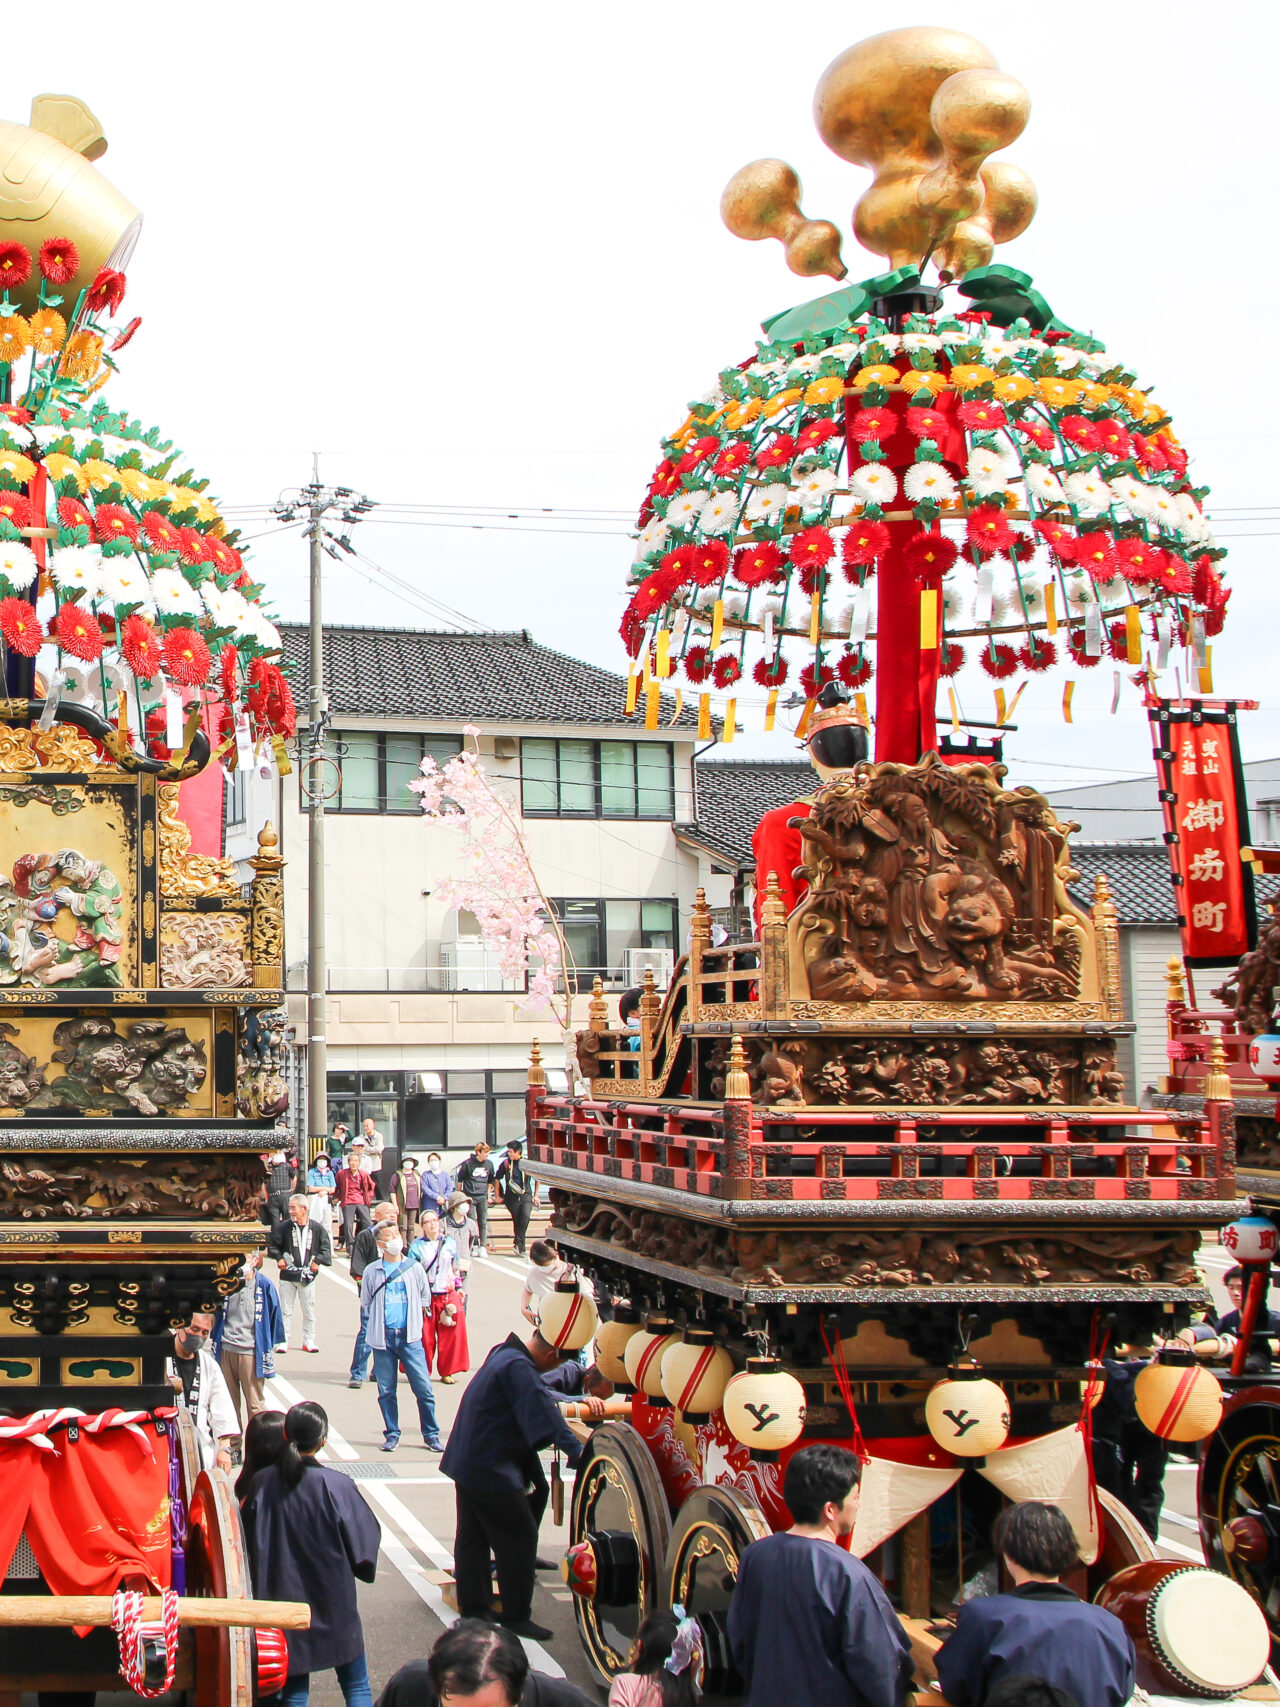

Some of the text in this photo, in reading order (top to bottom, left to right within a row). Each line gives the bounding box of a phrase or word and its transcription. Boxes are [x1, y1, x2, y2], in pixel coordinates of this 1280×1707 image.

[1181, 740, 1198, 776] 元祖
[1201, 738, 1218, 776] 曳山
[1181, 797, 1228, 933] 御坊町
